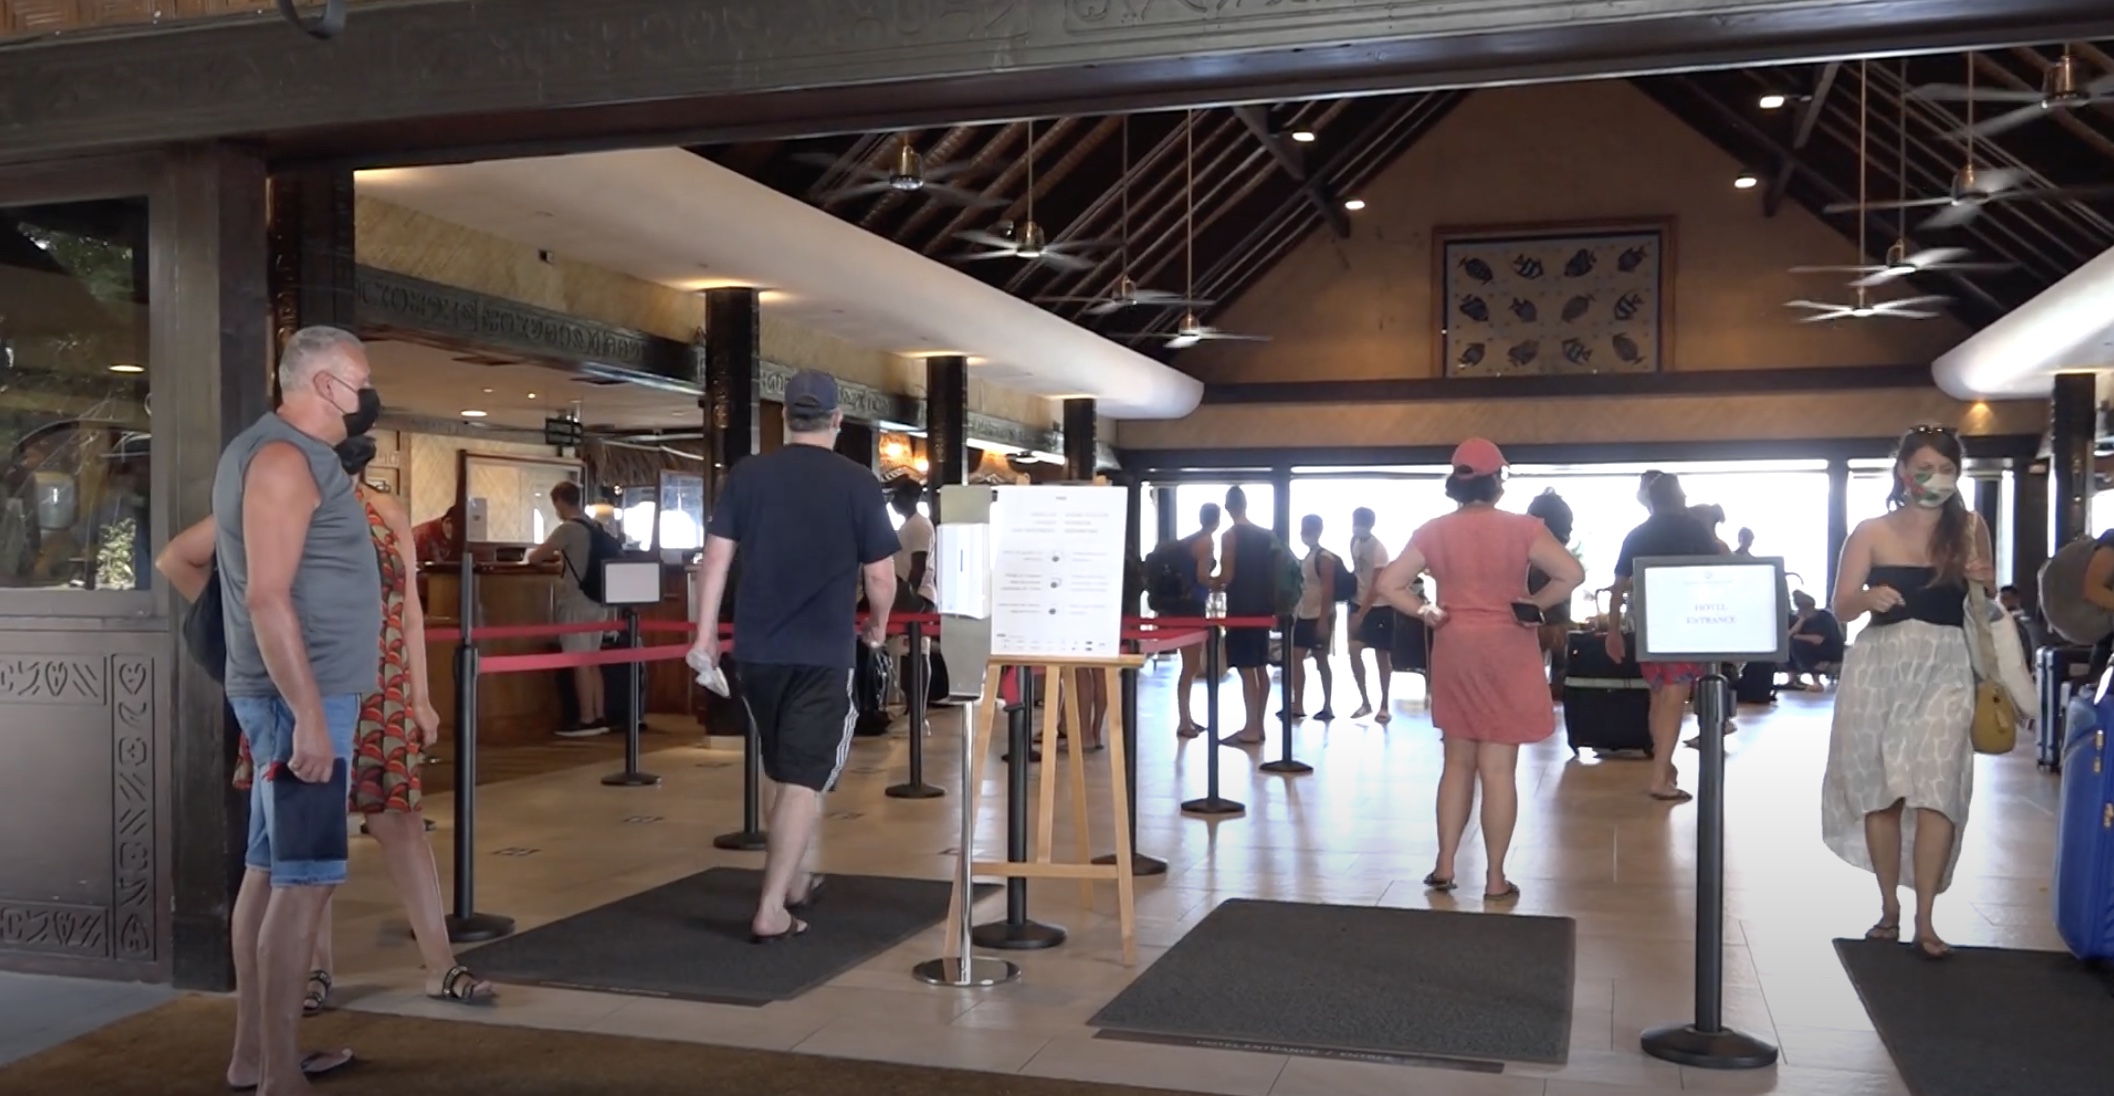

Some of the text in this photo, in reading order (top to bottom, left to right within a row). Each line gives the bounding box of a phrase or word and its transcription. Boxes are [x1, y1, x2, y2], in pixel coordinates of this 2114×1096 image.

[1694, 603, 1729, 612] HOTEL
[1686, 616, 1737, 624] ENTRANCE
[1243, 1043, 1319, 1055] ENTRANCE
